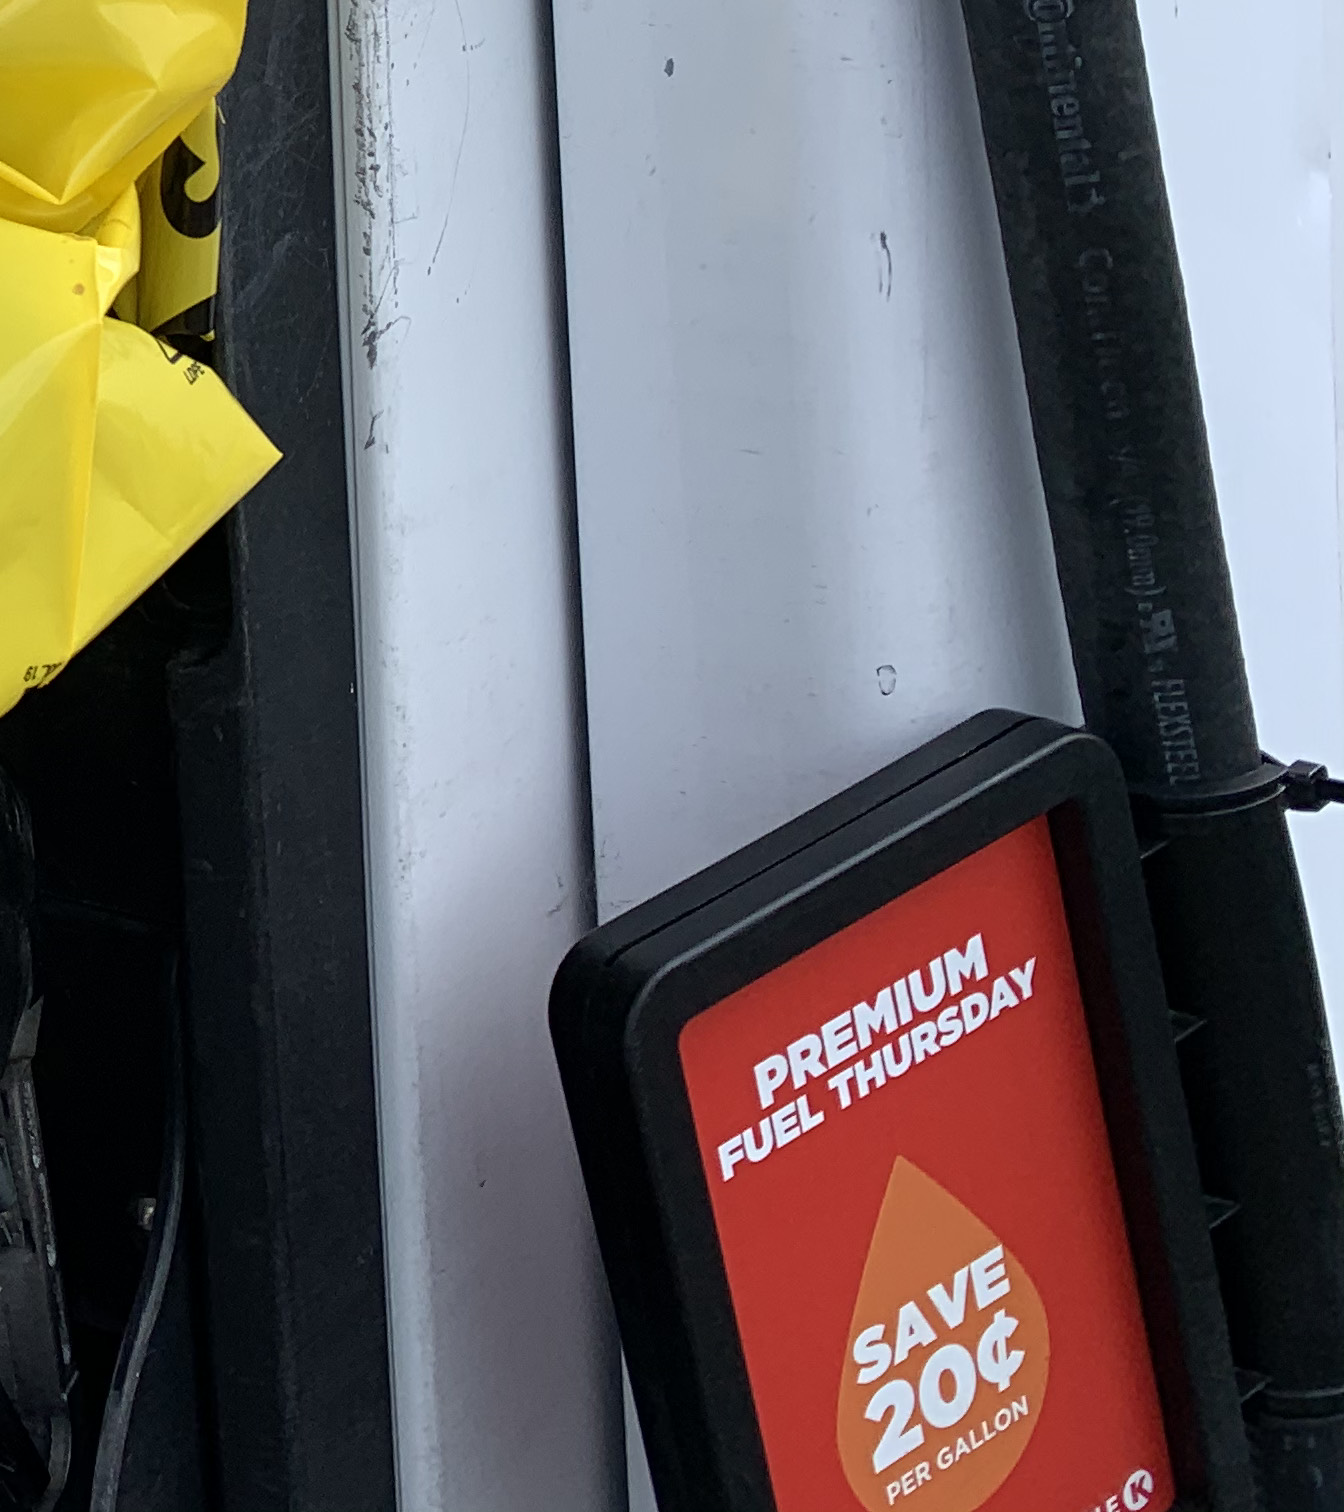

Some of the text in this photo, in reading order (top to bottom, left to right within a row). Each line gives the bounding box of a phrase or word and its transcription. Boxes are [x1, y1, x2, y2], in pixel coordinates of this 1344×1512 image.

[716, 957, 1038, 1183] FUEL THURSDAY
[753, 933, 989, 1109] PREMIUM
[851, 1245, 1011, 1386] SAVE
[864, 1309, 1026, 1475] 20¢
[885, 1395, 1030, 1507] PER GALLON
